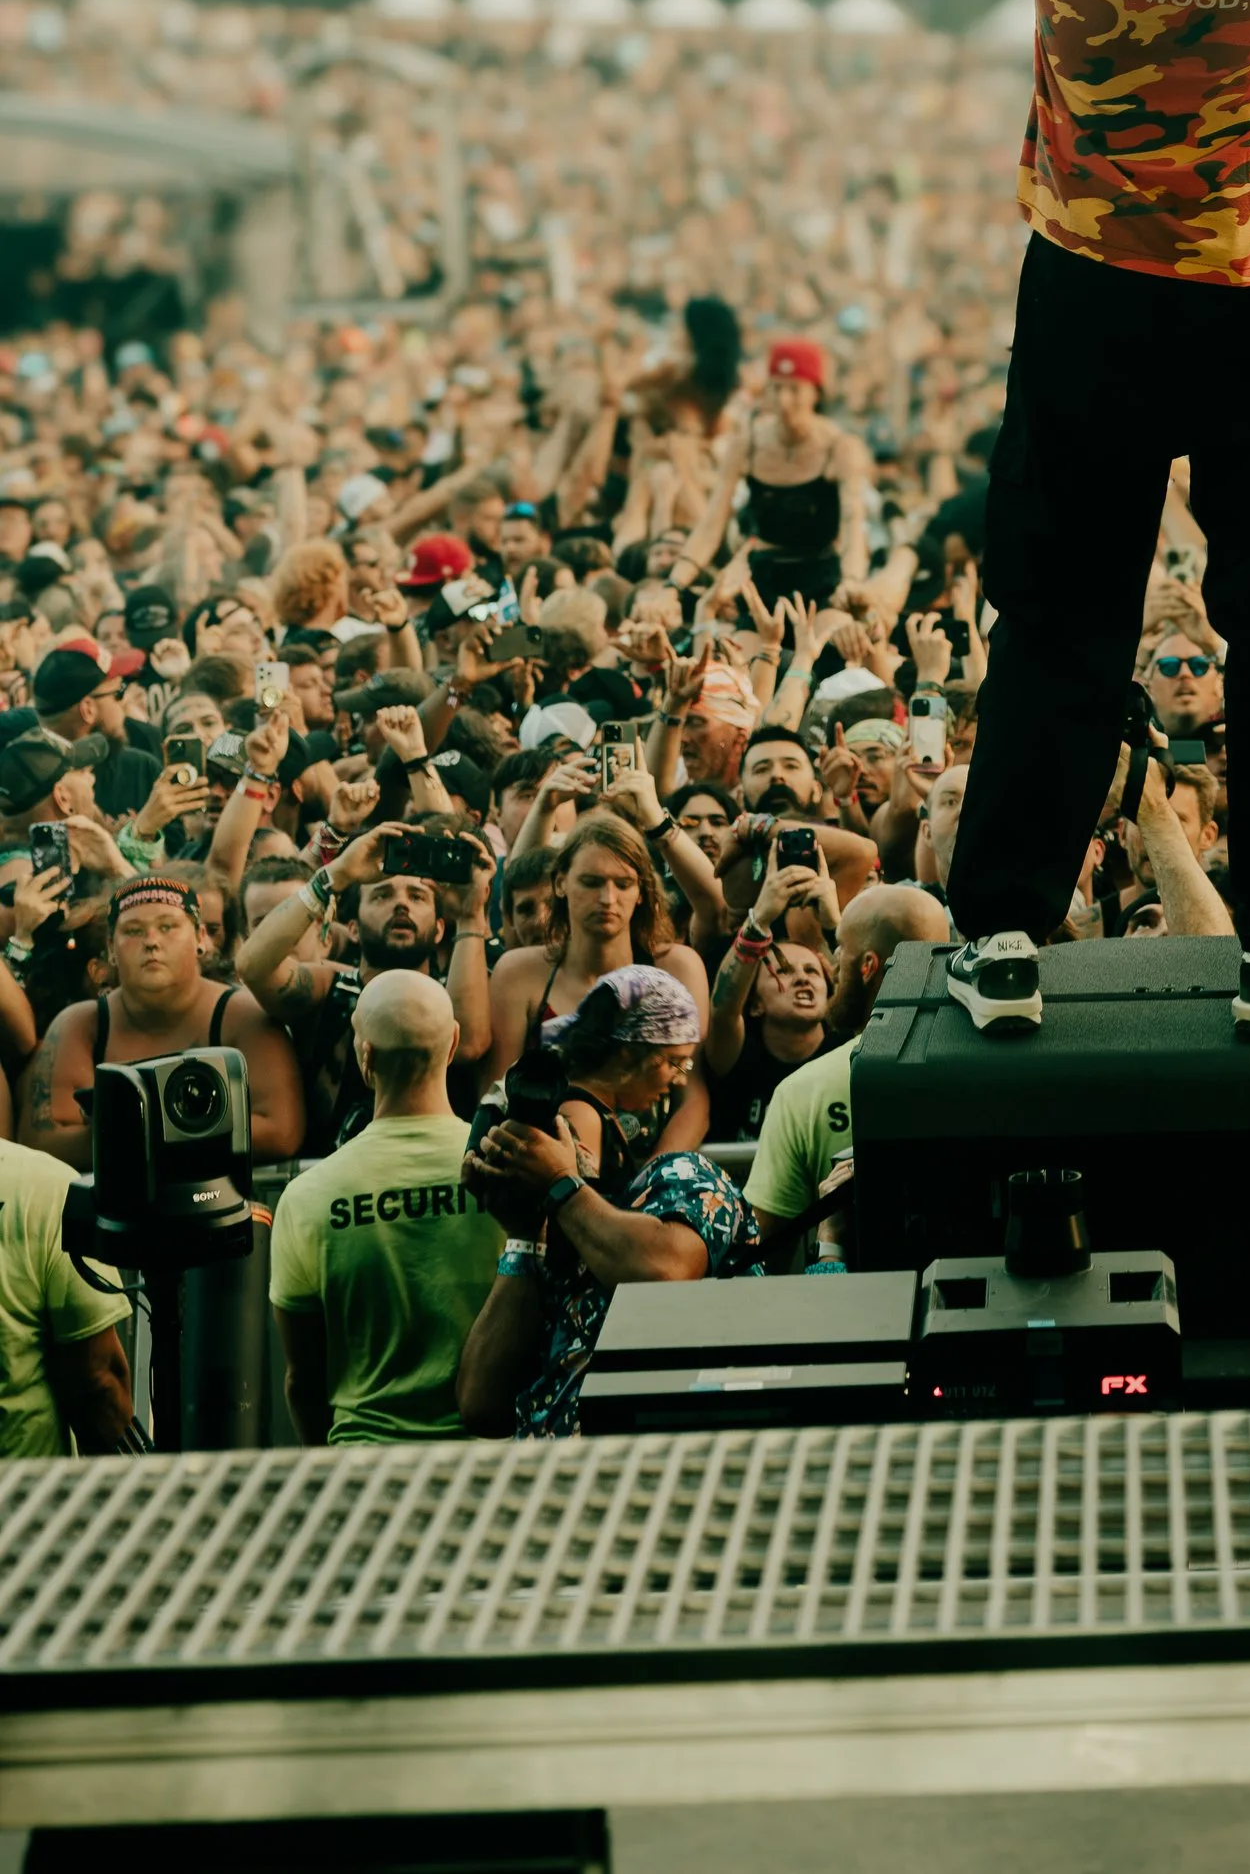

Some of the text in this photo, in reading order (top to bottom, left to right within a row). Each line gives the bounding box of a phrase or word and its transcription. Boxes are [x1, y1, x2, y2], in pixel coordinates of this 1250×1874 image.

[192, 1190, 221, 1203] SONY
[329, 1182, 487, 1230] SECURI
[1101, 1375, 1148, 1395] FX
